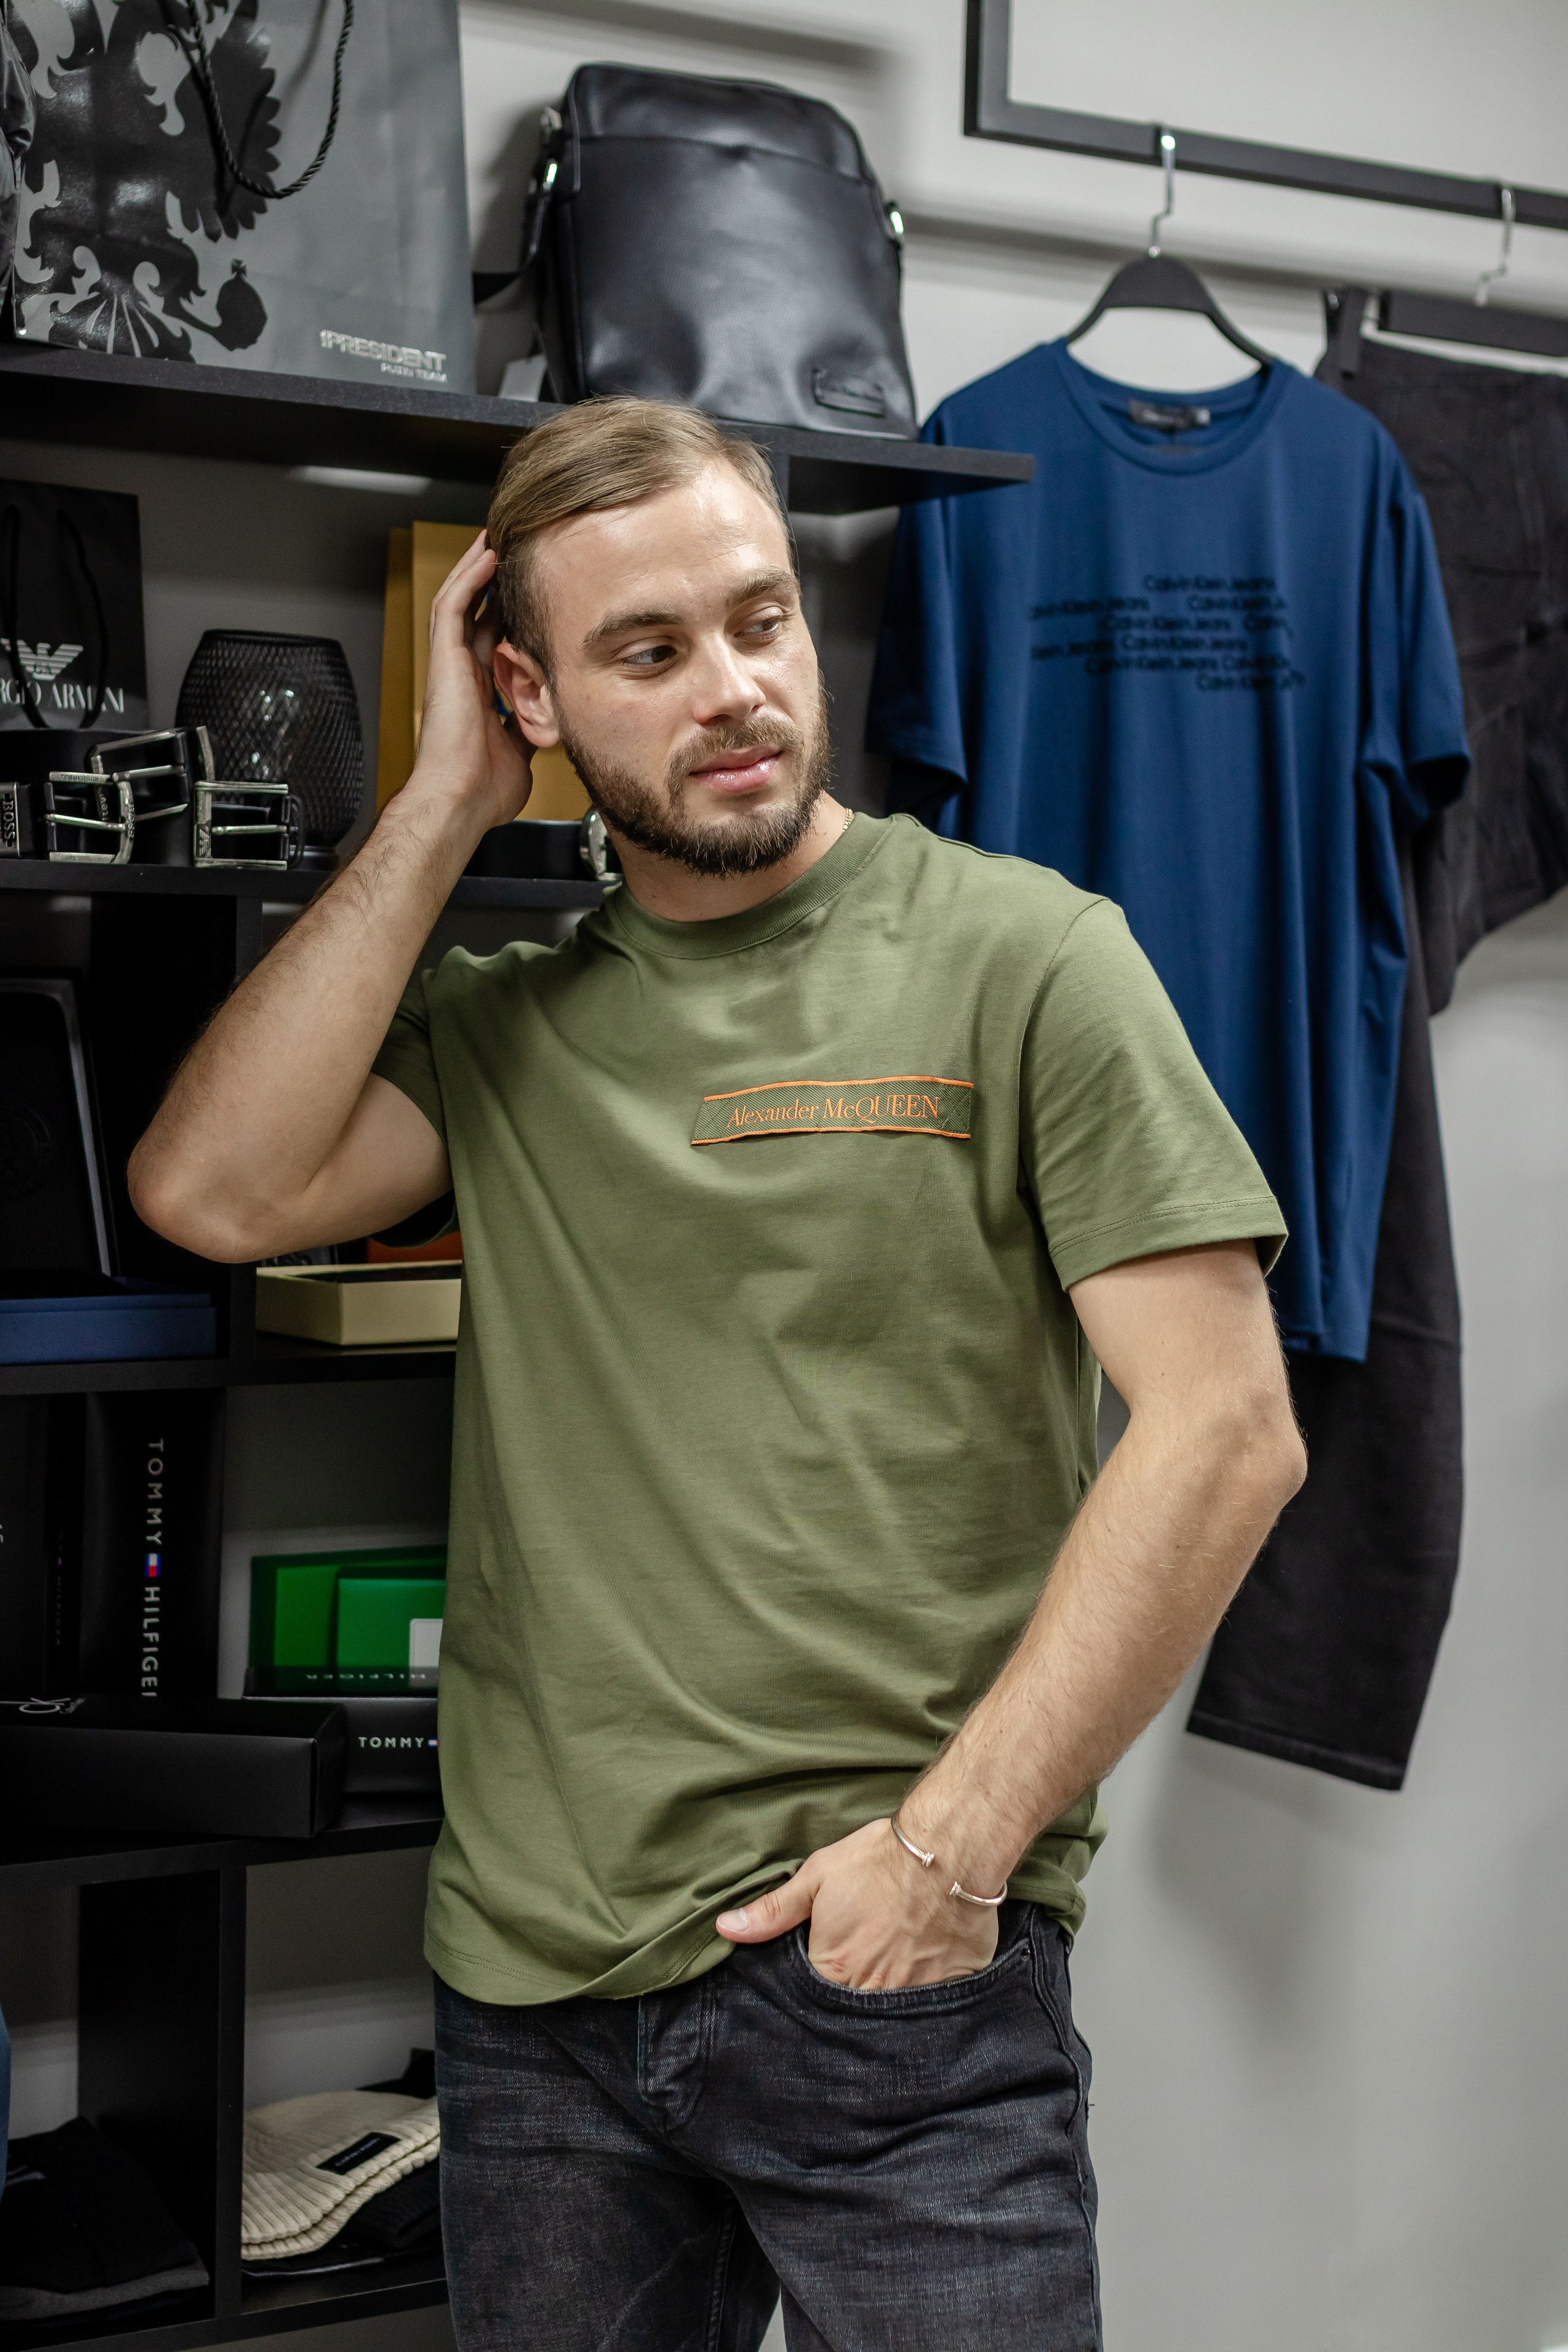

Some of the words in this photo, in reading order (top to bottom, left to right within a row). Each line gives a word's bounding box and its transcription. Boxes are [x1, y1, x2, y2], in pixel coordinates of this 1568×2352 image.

[326, 330, 447, 372] PRESIDENT
[2, 800, 15, 840] BOSS
[726, 1098, 820, 1128] Alexander
[822, 1095, 941, 1124] McQUEEN
[146, 1438, 164, 1545] TOMMY
[141, 1586, 161, 1697] HILFIGE
[358, 1736, 424, 1748] TOMMY
